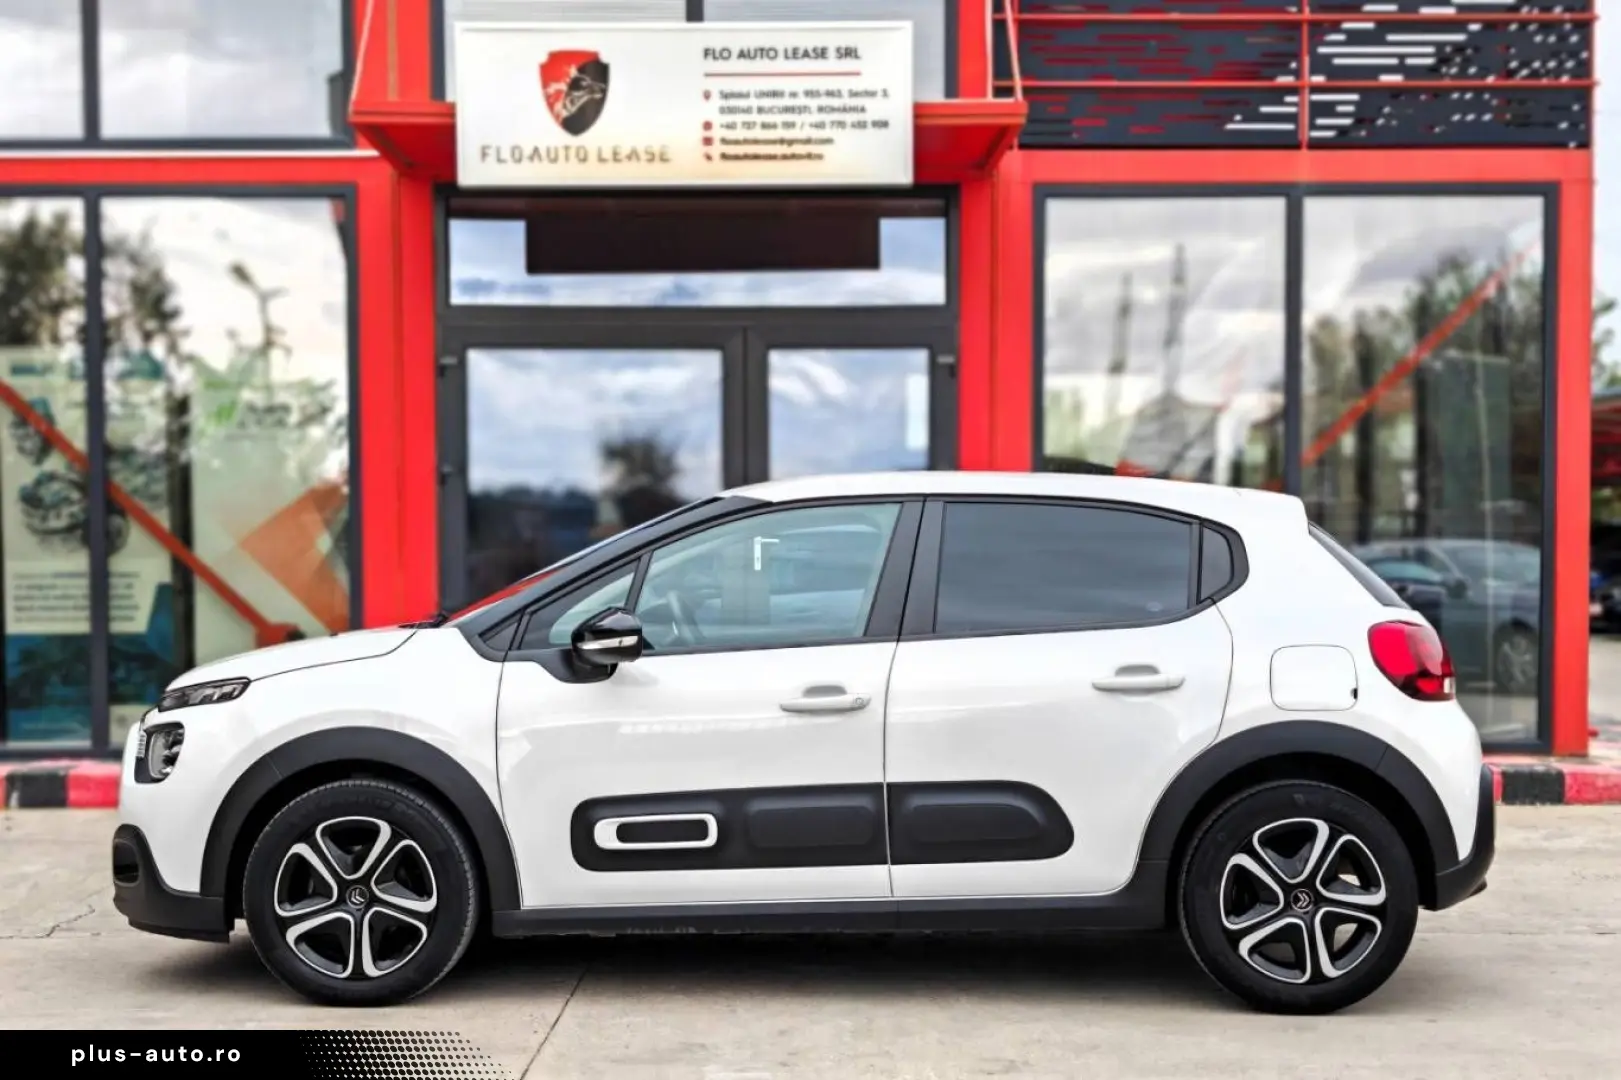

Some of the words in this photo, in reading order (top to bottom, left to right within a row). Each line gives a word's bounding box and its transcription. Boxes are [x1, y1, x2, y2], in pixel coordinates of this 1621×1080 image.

[703, 47, 732, 61] FLO
[736, 46, 779, 61] AUTO
[783, 46, 829, 60] LEASE
[835, 46, 861, 60] SRL
[597, 144, 673, 163] LEASE
